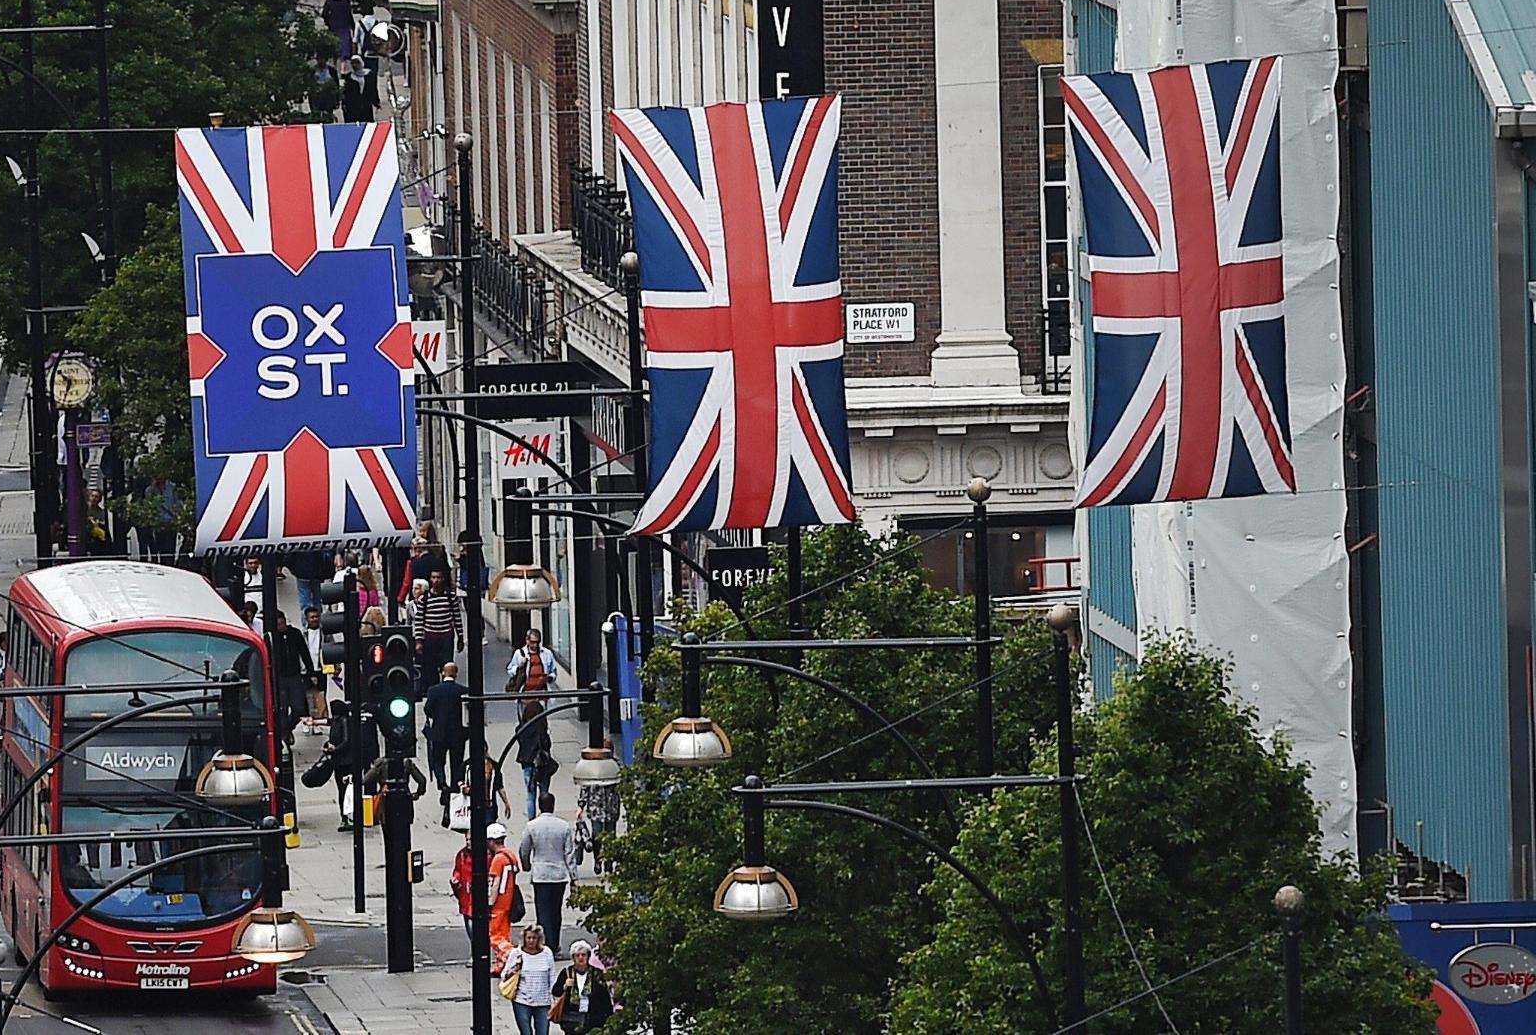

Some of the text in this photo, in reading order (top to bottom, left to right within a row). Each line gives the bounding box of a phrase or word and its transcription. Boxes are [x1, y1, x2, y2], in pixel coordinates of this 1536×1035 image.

[853, 307, 908, 318] STRATFORD
[853, 320, 900, 330] PLACE W1
[251, 303, 346, 350] OX
[256, 352, 350, 400] ST.
[504, 433, 551, 467] H&M
[101, 752, 175, 772] Aldwych
[135, 964, 191, 975] Metroline
[1456, 961, 1536, 996] Disney
